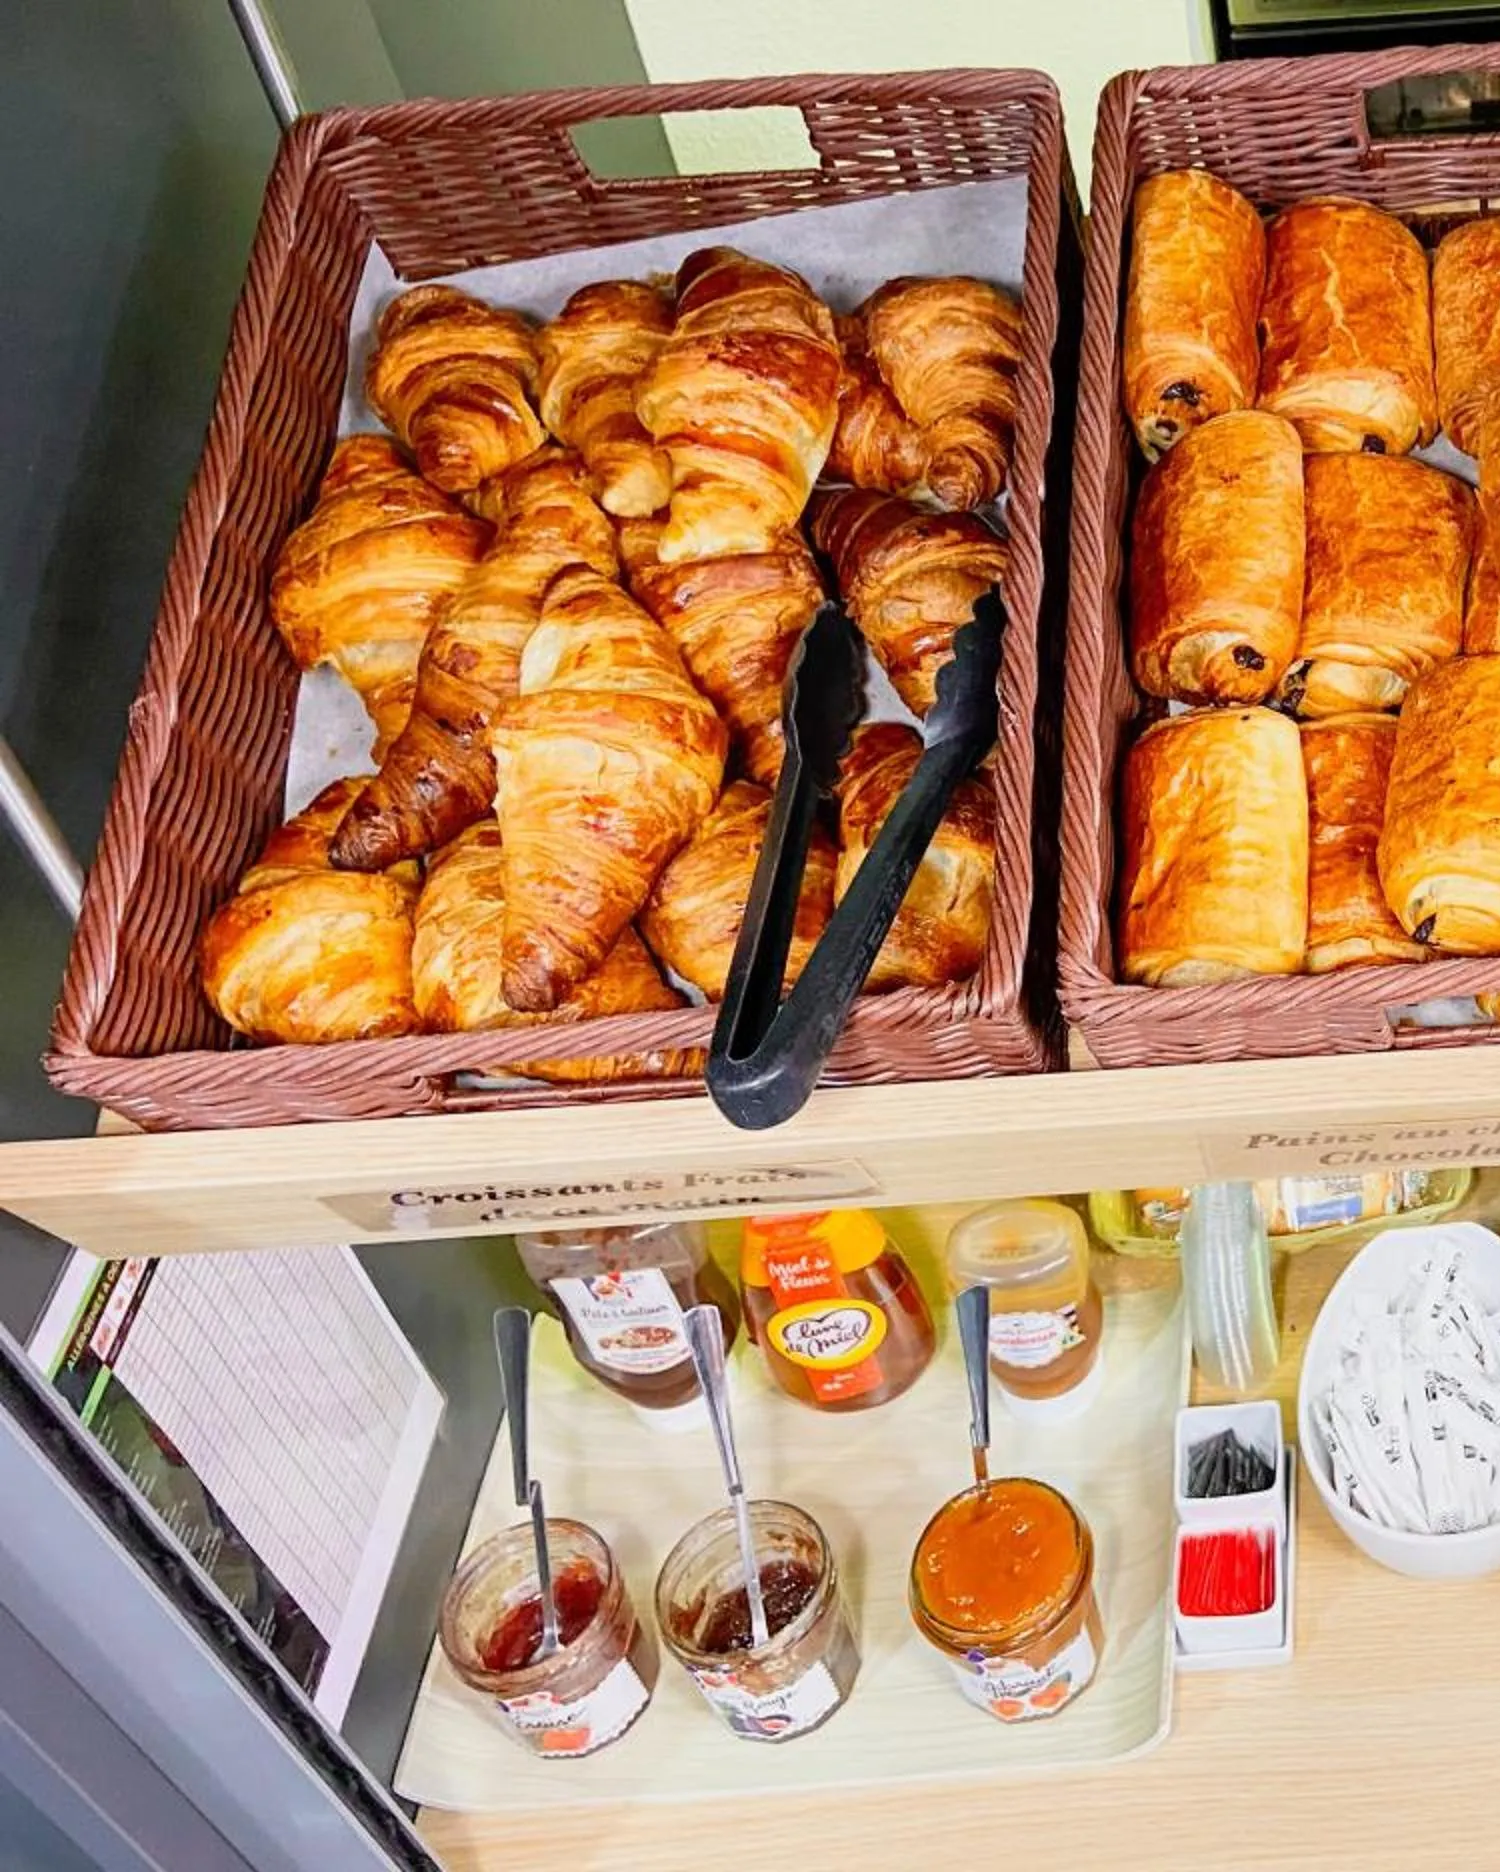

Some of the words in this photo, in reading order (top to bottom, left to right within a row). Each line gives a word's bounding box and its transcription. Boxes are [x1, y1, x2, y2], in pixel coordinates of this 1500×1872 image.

[1244, 1131, 1376, 1150] Pains
[1394, 1127, 1449, 1141] au
[390, 1179, 663, 1207] Croissants
[768, 1255, 810, 1277] Miel
